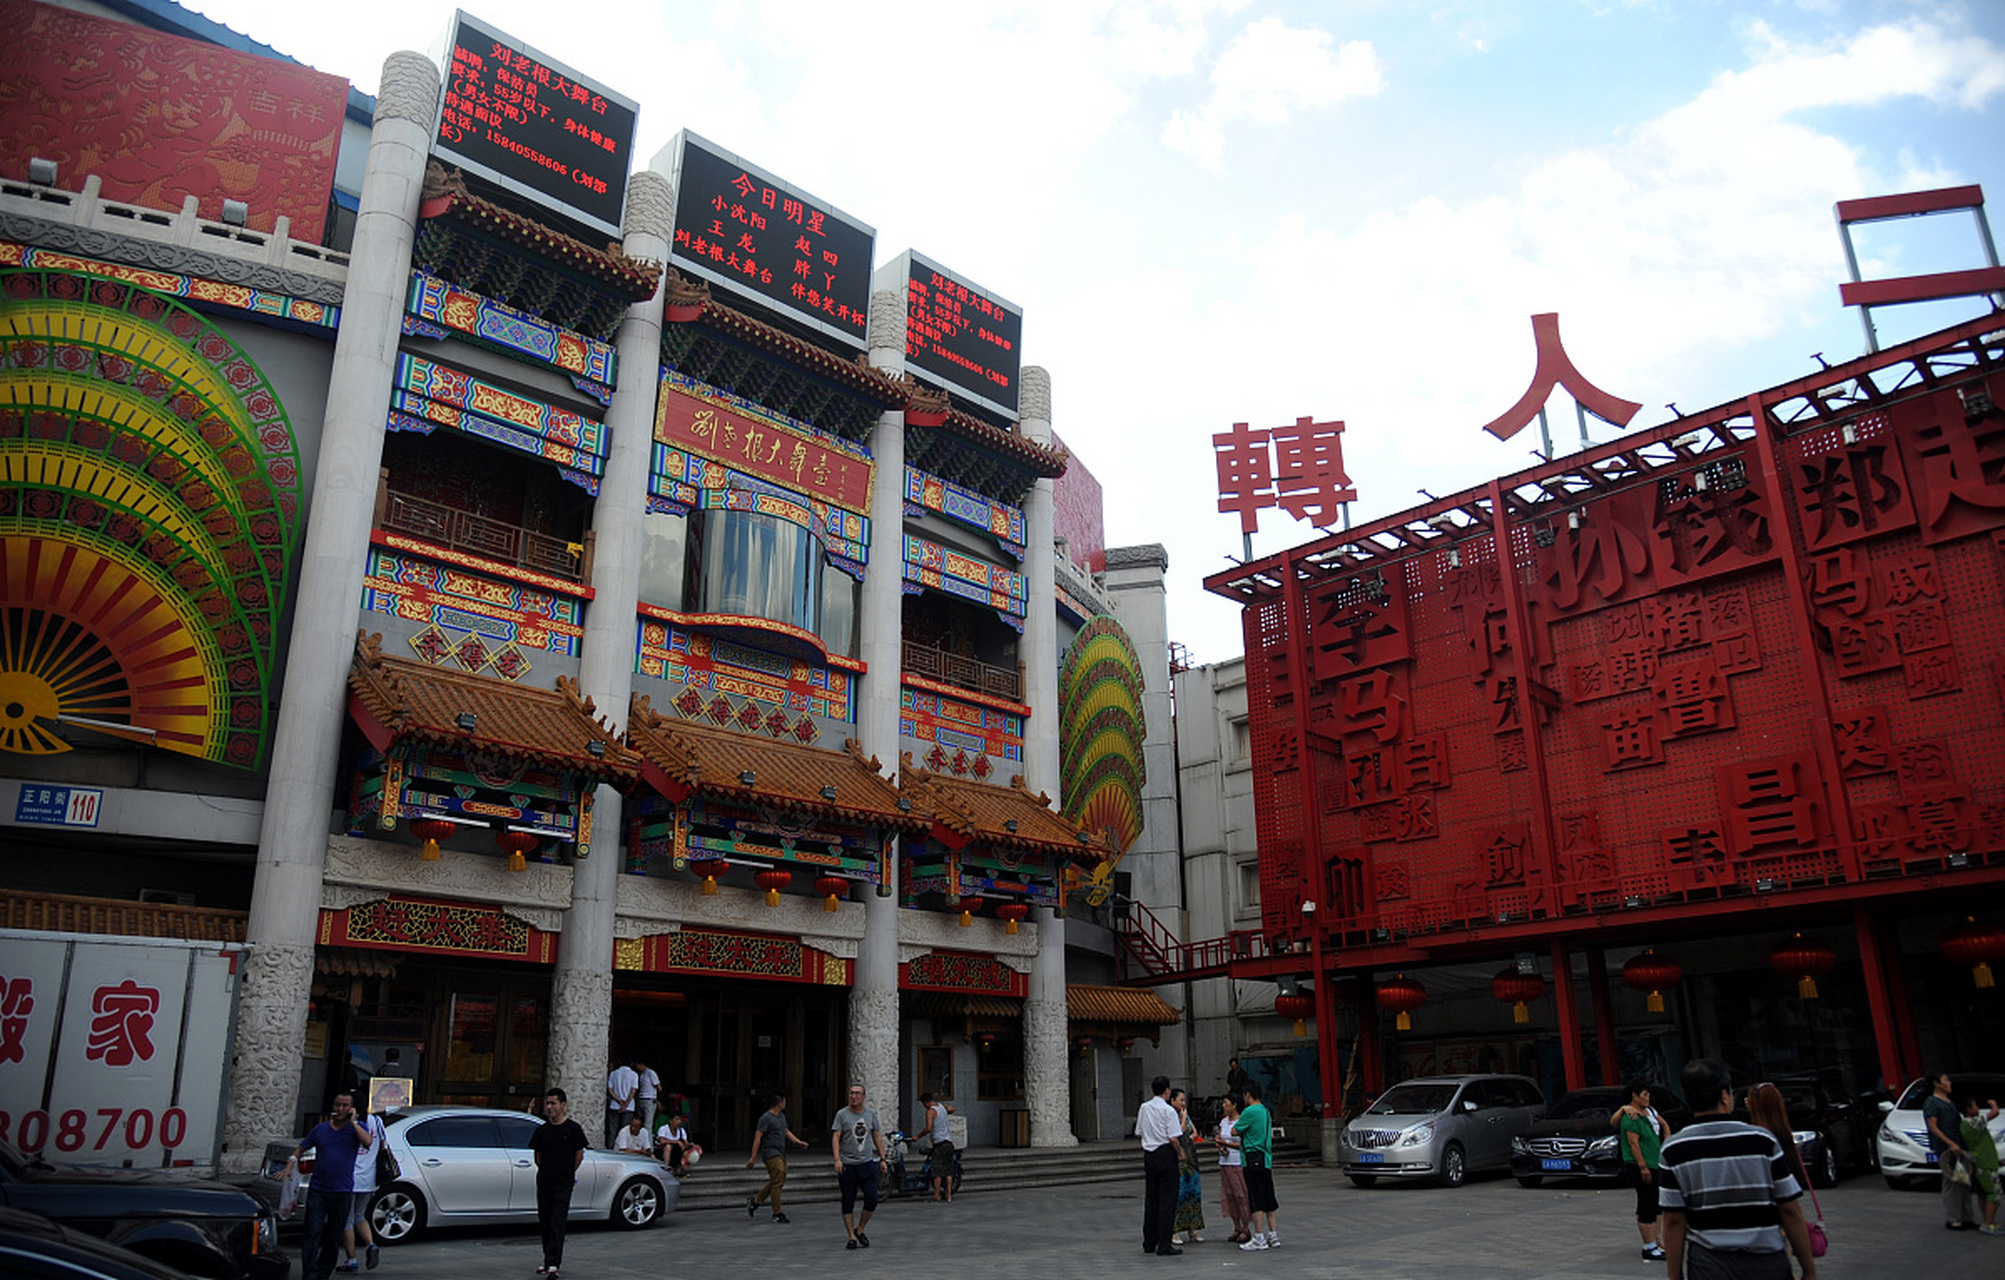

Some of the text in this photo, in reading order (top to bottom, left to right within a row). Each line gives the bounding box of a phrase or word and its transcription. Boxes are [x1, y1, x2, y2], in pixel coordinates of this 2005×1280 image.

[248, 89, 325, 123] 吉祥
[490, 43, 608, 115] 刘老根大舞台
[712, 195, 766, 230] 小沈阳
[731, 173, 826, 237] 今日明星
[674, 228, 866, 327] 刘老根大舞台 伴您笑开怀
[1483, 312, 1643, 441] 人
[1802, 445, 1899, 545] 郑
[1602, 708, 1653, 767] 苗
[72, 794, 96, 821] 110
[1399, 797, 1435, 838] 张
